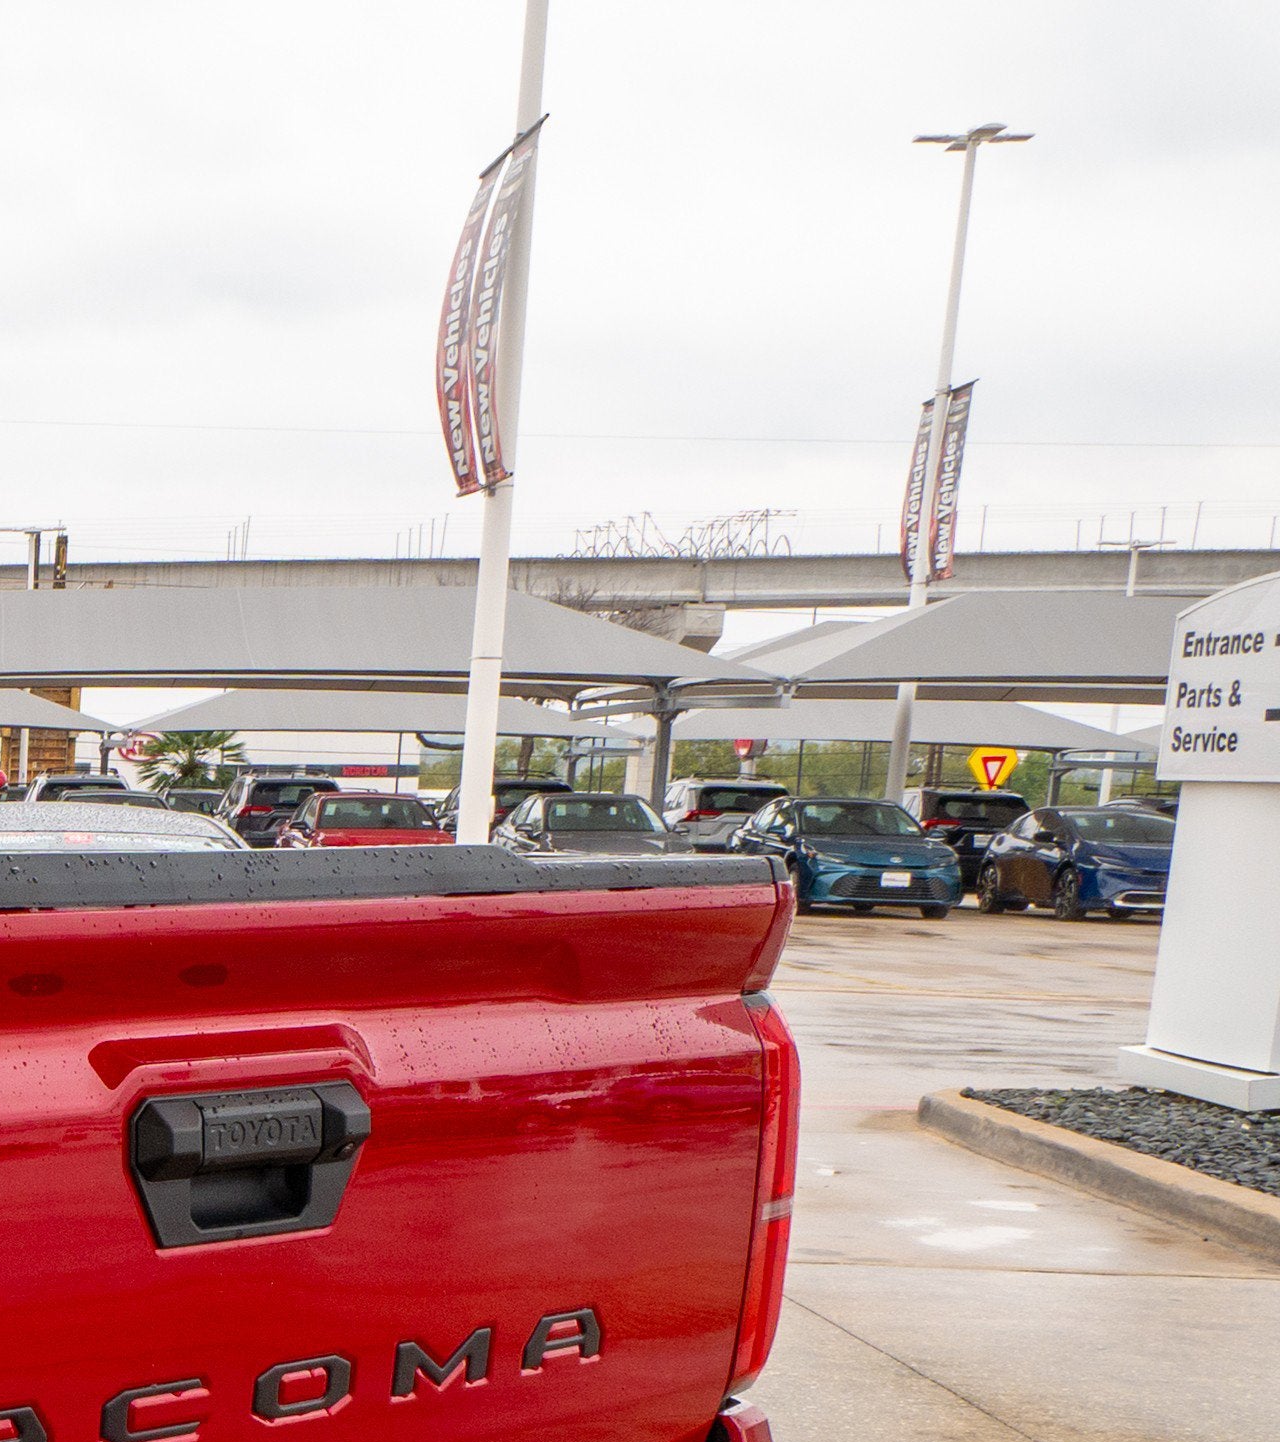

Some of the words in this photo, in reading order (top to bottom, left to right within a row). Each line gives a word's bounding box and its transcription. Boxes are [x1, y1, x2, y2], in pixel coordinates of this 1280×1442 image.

[444, 238, 473, 393] Vehicles
[475, 212, 508, 376] Vehicles
[449, 400, 469, 477] New
[476, 382, 497, 465] New
[937, 431, 959, 520] Vehicles
[935, 523, 951, 570] New
[1182, 631, 1265, 658] Entrance
[1176, 681, 1222, 708] Parts
[1228, 680, 1242, 707] &
[1171, 726, 1238, 753] Service
[343, 766, 371, 776] WORLD
[371, 766, 388, 776] CAR
[210, 1114, 318, 1150] TOYOTA
